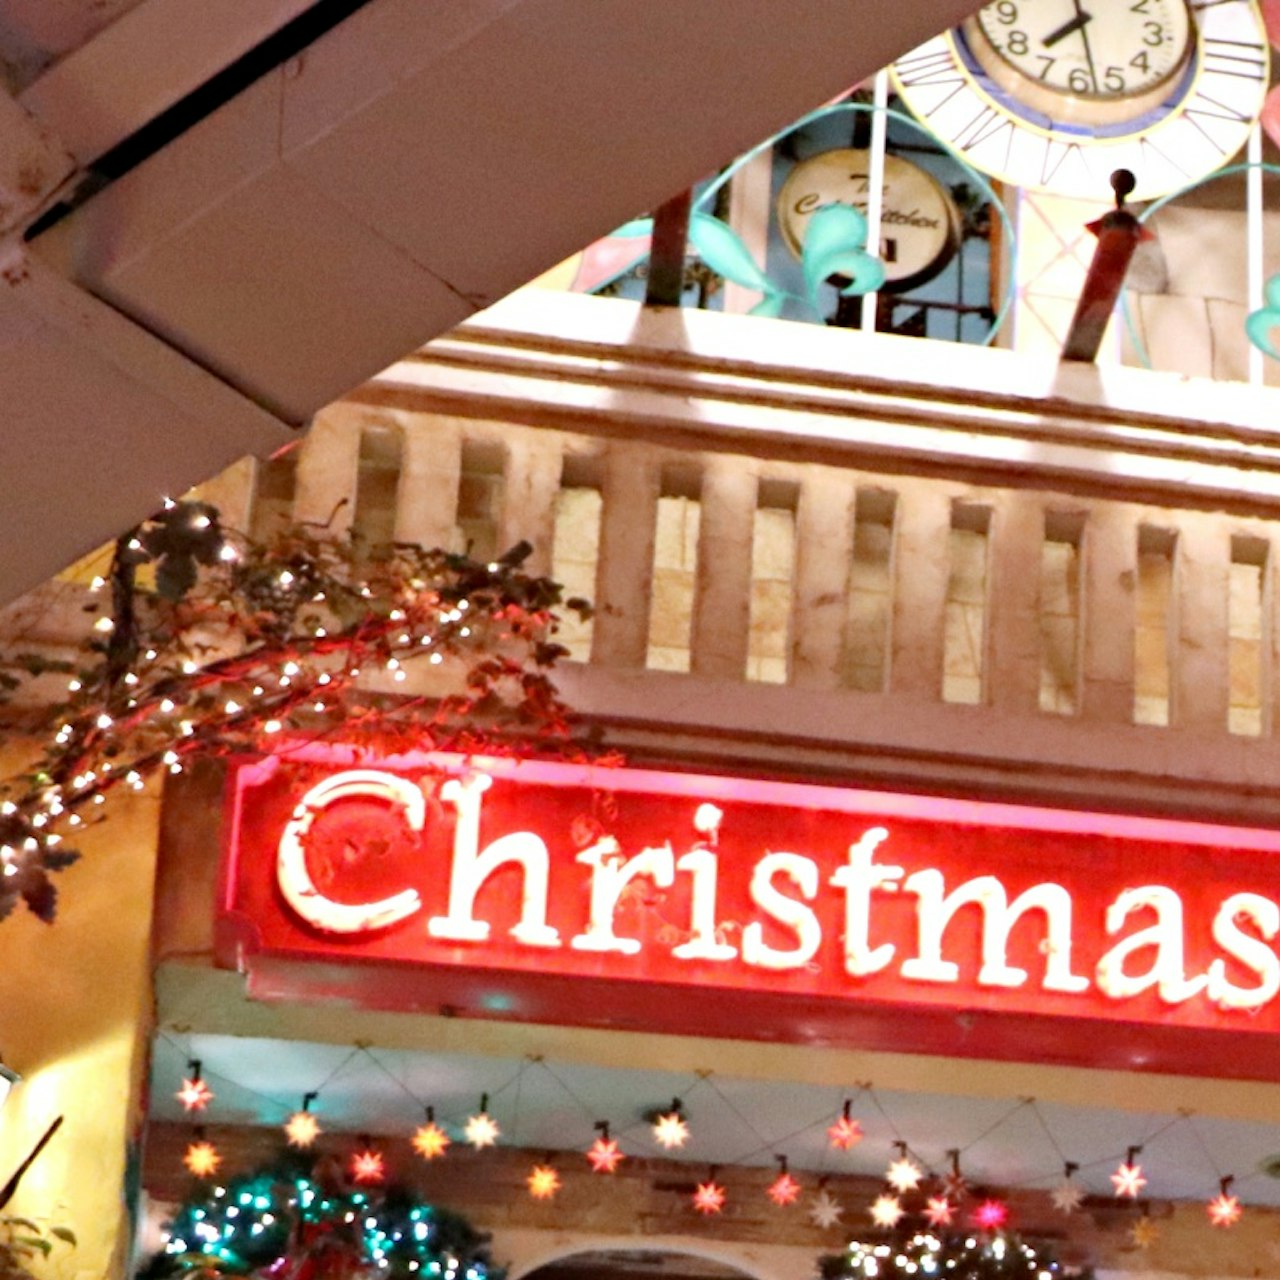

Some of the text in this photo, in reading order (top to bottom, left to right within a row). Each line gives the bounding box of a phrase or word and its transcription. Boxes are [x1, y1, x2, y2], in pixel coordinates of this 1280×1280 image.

[997, 1, 1018, 25] 9
[1007, 30, 1028, 55] 8
[1142, 21, 1163, 47] 3
[1036, 55, 1056, 80] 7
[1129, 51, 1150, 75] 4
[1068, 68, 1089, 94] 6
[1104, 66, 1125, 92] 5
